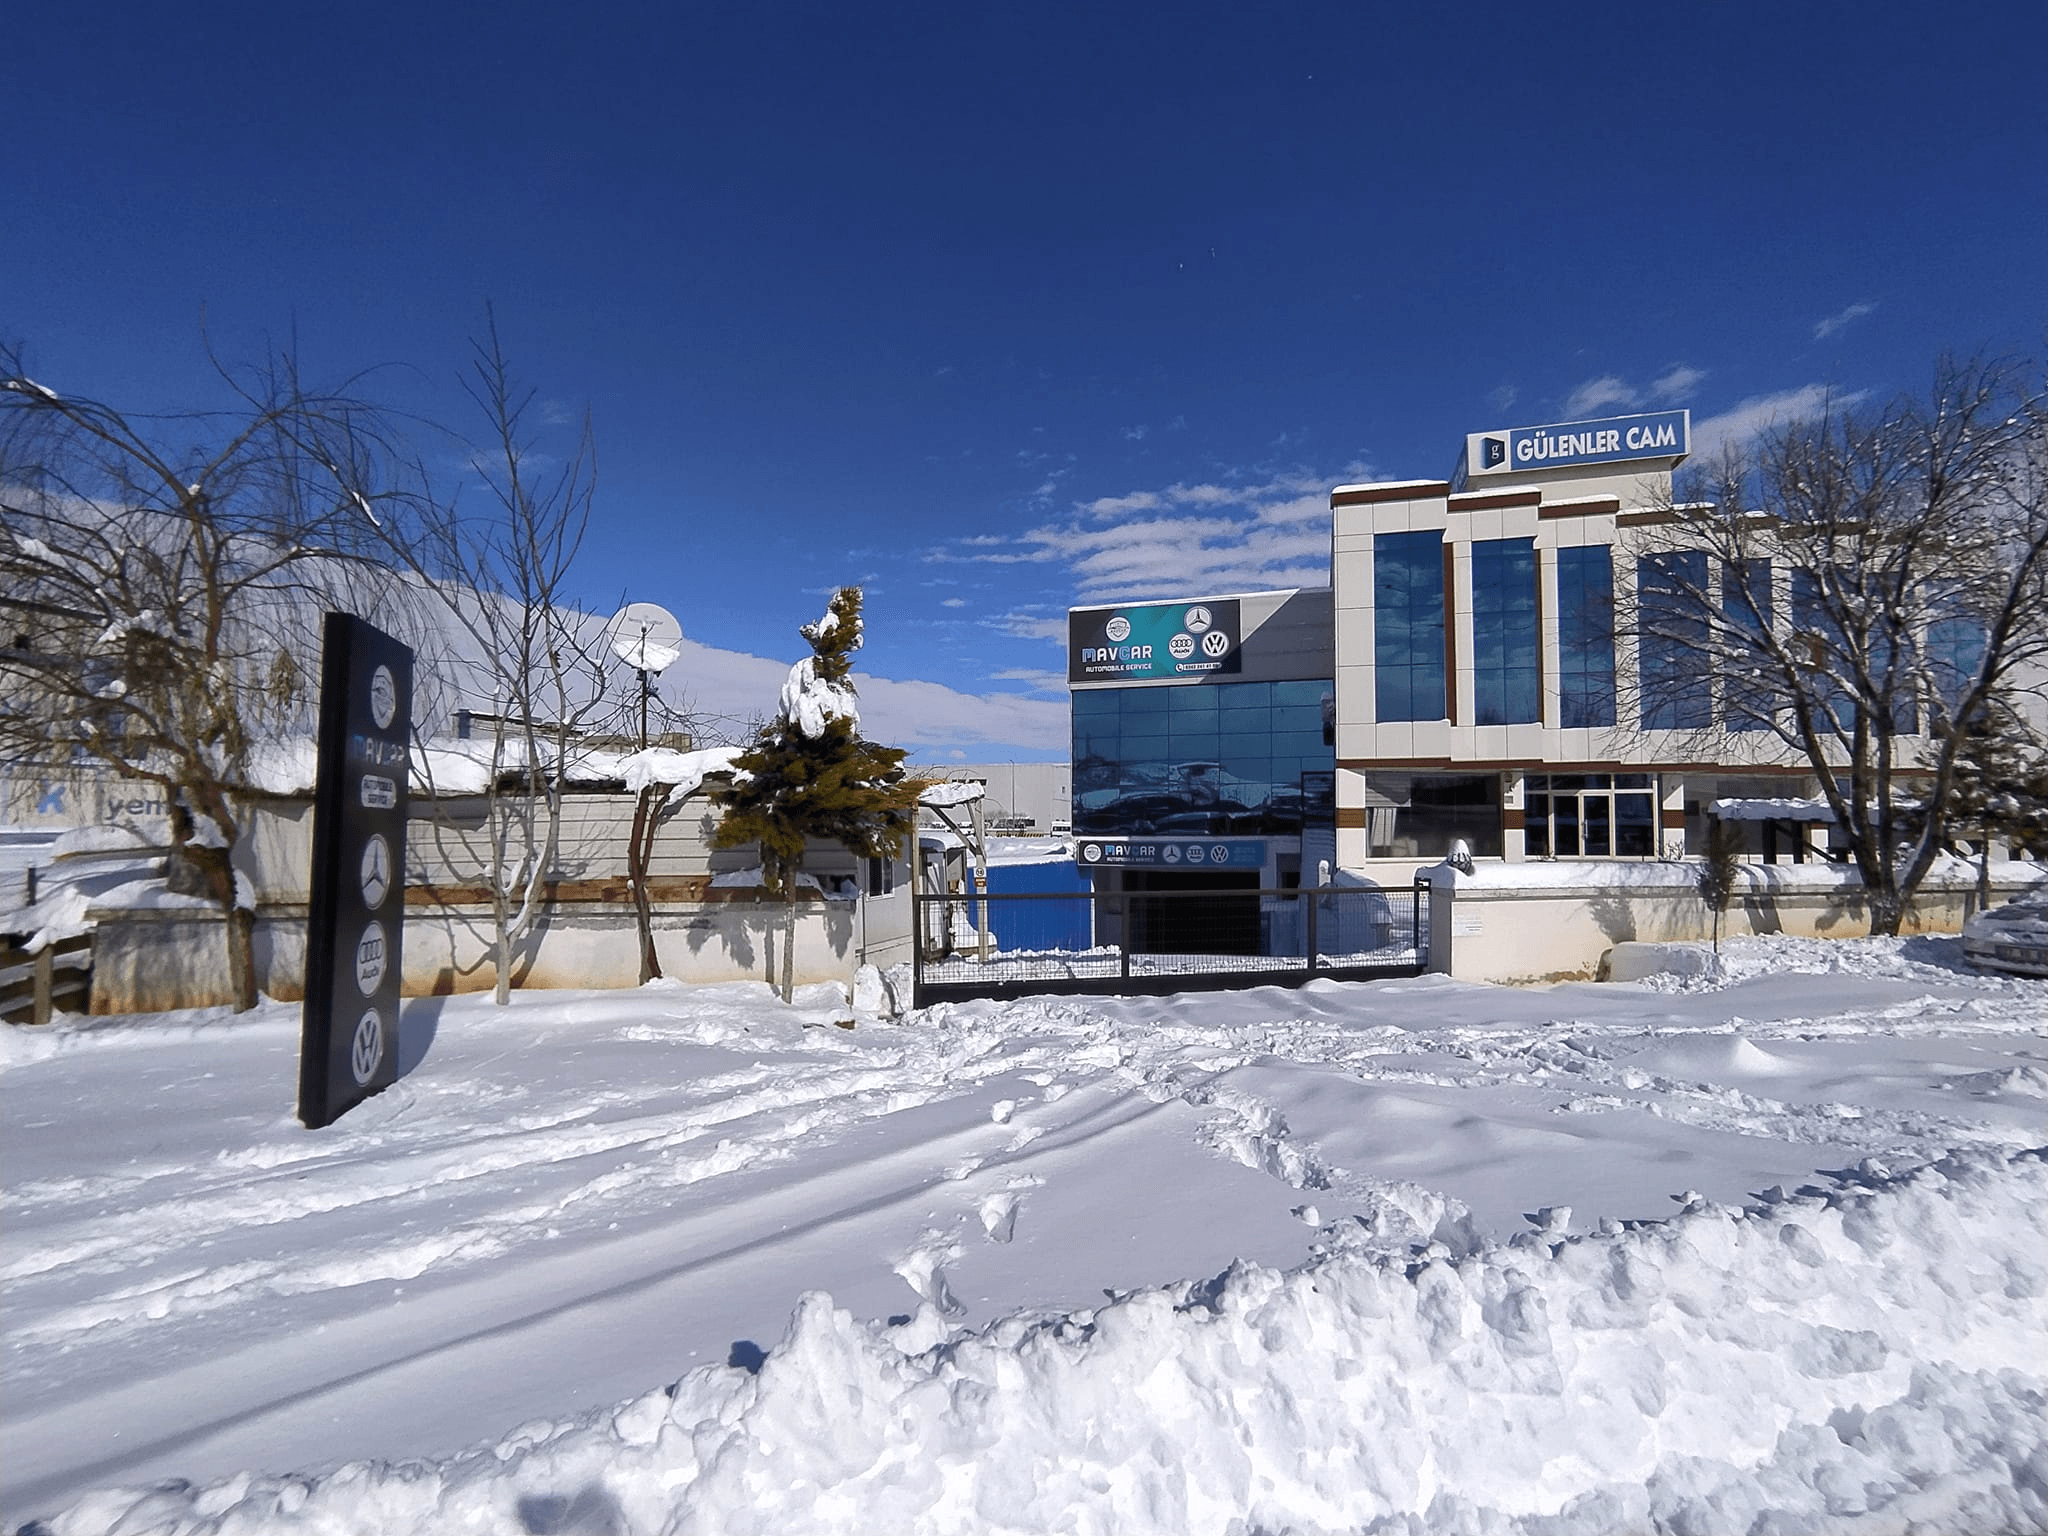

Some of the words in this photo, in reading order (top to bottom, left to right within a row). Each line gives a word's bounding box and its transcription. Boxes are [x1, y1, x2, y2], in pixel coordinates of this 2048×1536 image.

[1516, 430, 1621, 461] GÜLENLER
[1625, 424, 1676, 450] CAM
[1082, 645, 1153, 663] MAVCAR
[1085, 664, 1125, 673] AUTOMOBILE
[1125, 663, 1153, 671] SERVICE
